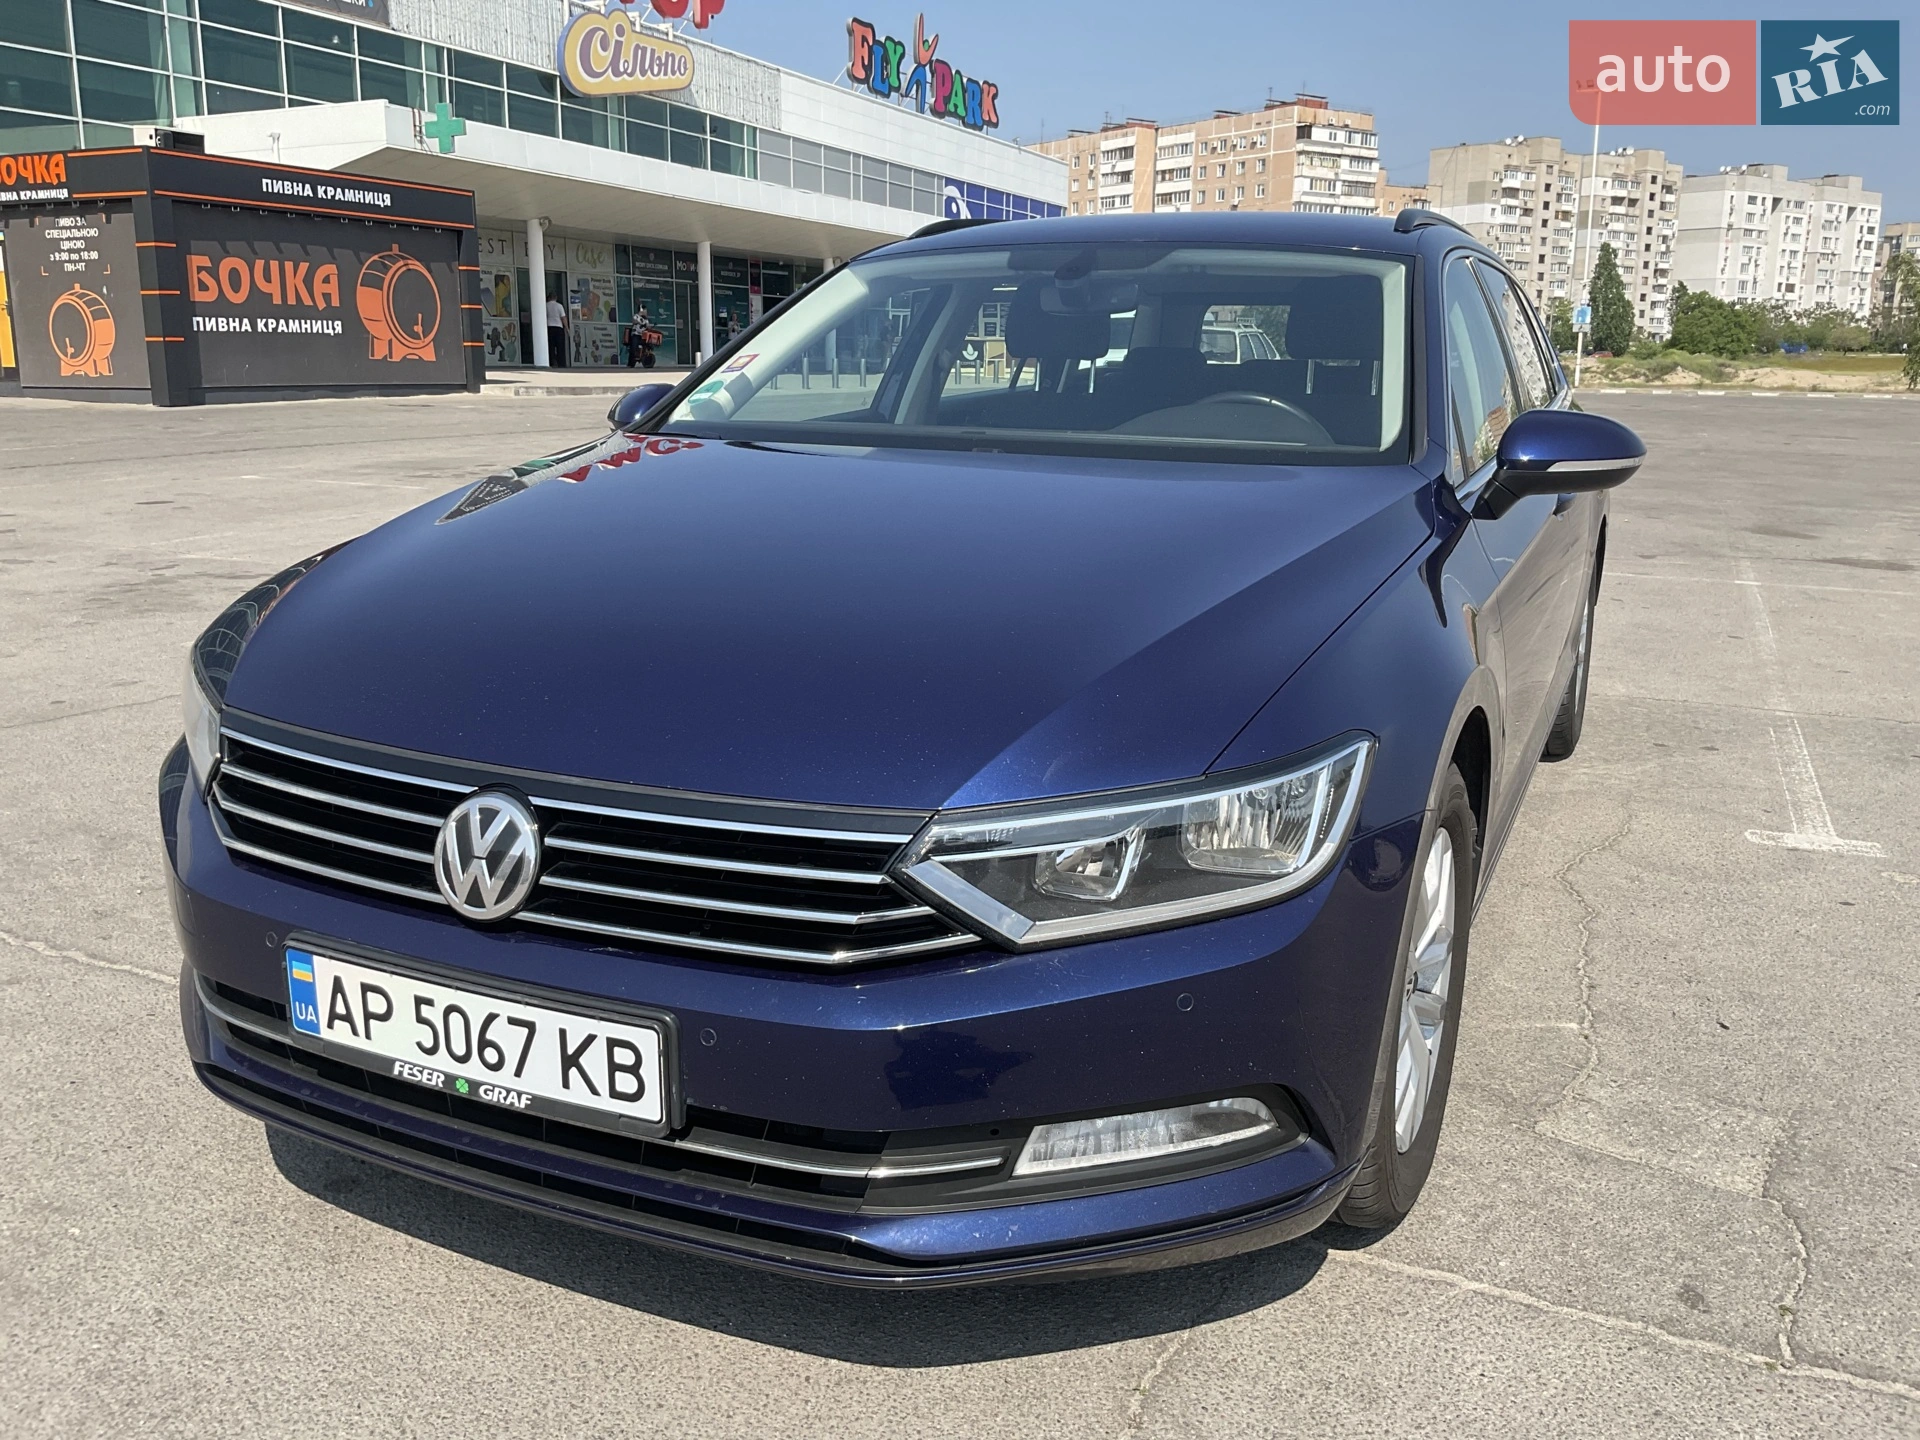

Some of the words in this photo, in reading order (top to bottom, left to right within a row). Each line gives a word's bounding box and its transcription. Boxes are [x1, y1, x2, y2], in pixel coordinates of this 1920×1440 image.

[579, 23, 689, 79] Сільпо
[847, 17, 905, 98] FLY
[931, 58, 999, 131] PARK
[0, 153, 67, 186] ОЧКА
[20, 188, 69, 201] КРАМНИЦЯ
[261, 178, 314, 197] ПИВНА
[317, 185, 392, 208] КРАМНИЦЯ
[45, 227, 99, 239] СПЕЦІАЛЬНОЮ
[55, 217, 75, 227] ПИВО
[76, 216, 87, 226] ЗА
[55, 252, 69, 261] 9:00
[80, 251, 99, 260] 18:00
[60, 240, 86, 250] ЦІНОЮ
[64, 263, 86, 271] ПН-ЧТ
[186, 254, 340, 311] БОЧКА
[192, 316, 252, 332] ПИВНА
[257, 318, 343, 336] КРАМНИЦЯ
[296, 1001, 317, 1024] UA
[326, 975, 394, 1040] AP
[413, 993, 536, 1078] 5067
[559, 1027, 645, 1103] KB
[393, 1060, 445, 1088] FESER
[479, 1083, 532, 1110] GRAF
